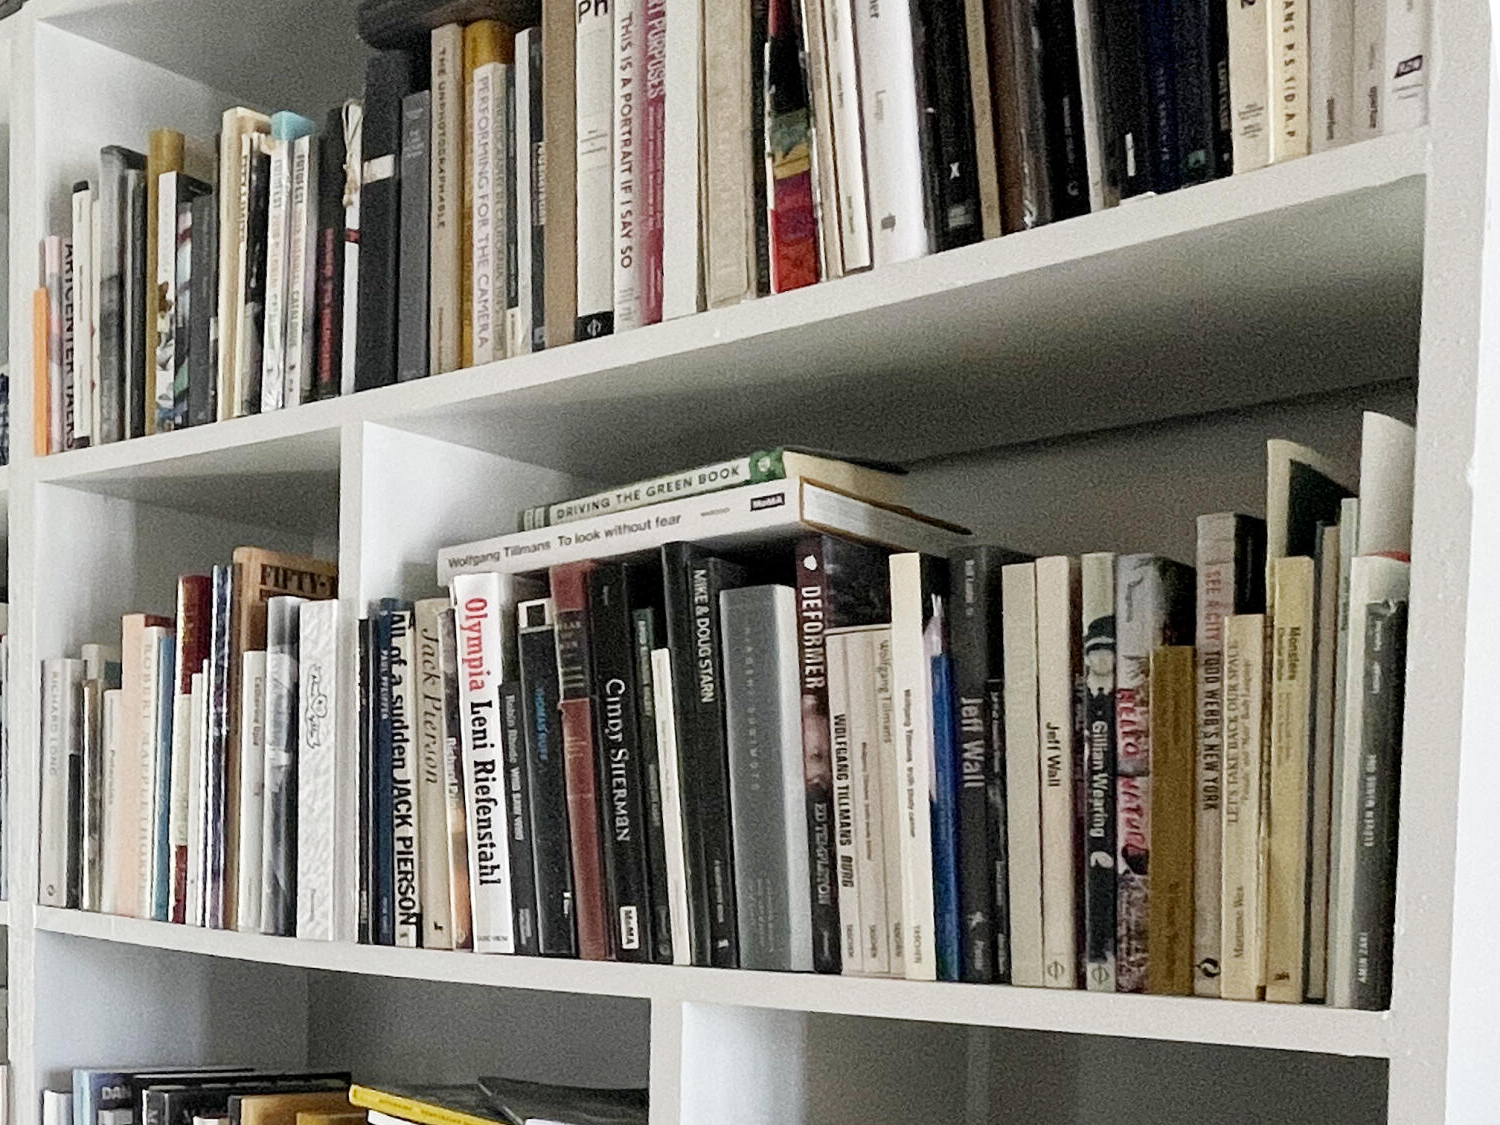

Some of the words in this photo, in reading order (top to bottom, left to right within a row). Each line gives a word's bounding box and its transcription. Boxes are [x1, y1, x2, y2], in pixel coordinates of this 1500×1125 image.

[620, 12, 633, 52] THIS
[620, 56, 632, 71] IS
[620, 78, 632, 89] A
[1369, 86, 1379, 129] aperture
[477, 77, 491, 189] PERFORMING
[620, 93, 633, 174] PORTRAIT
[620, 179, 633, 194] IF
[477, 194, 490, 227] FOR
[620, 210, 633, 239] SAY
[477, 233, 490, 269] THE
[620, 246, 633, 269] SO
[477, 274, 490, 348] CAMERA
[557, 497, 610, 521] DRIVING
[616, 488, 641, 505] THE
[645, 478, 693, 500] GREEN
[697, 465, 741, 487] BOOK
[448, 549, 501, 570] Wolfgang
[504, 539, 551, 559] Tillmans
[557, 534, 572, 547] To
[574, 526, 601, 544] look
[604, 519, 652, 540] without
[655, 512, 682, 530] fear
[692, 569, 710, 604] MIKE
[390, 613, 405, 638] All
[697, 605, 710, 616] &
[390, 646, 406, 668] of
[421, 628, 441, 688] Jack
[460, 598, 491, 692] Olympia
[695, 618, 712, 657] DOUG
[802, 586, 824, 689] DEFORMER
[1286, 626, 1301, 682] Monsters
[391, 674, 403, 687] a
[698, 658, 715, 703] STARN
[877, 639, 891, 694] Wolfgang
[1203, 651, 1219, 685] TODD
[49, 671, 61, 733] RICHARD
[880, 696, 894, 744] Tillmans
[960, 697, 984, 733] Jeff
[1204, 689, 1220, 740] WEBB'S
[390, 694, 407, 770] sudden
[422, 694, 442, 785] Pierson
[470, 700, 494, 752] Leni
[508, 729, 519, 763] Rhode
[834, 713, 849, 781] WOLFGANG
[1045, 722, 1062, 751] Jeff
[1092, 721, 1109, 771] Gillian
[48, 736, 59, 777] LONG
[962, 740, 986, 789] Wall
[1046, 756, 1062, 788] Wall
[1204, 744, 1219, 772] NEW
[392, 777, 414, 831] JACK
[838, 784, 852, 847] TILLMANS
[1088, 773, 1109, 838] Wearing
[1203, 777, 1219, 812] YORK
[474, 760, 502, 887] Riefenstahl
[395, 836, 416, 926] PIERSON
[815, 824, 830, 905] TEMPLETON
[912, 924, 923, 964] TASCHEN
